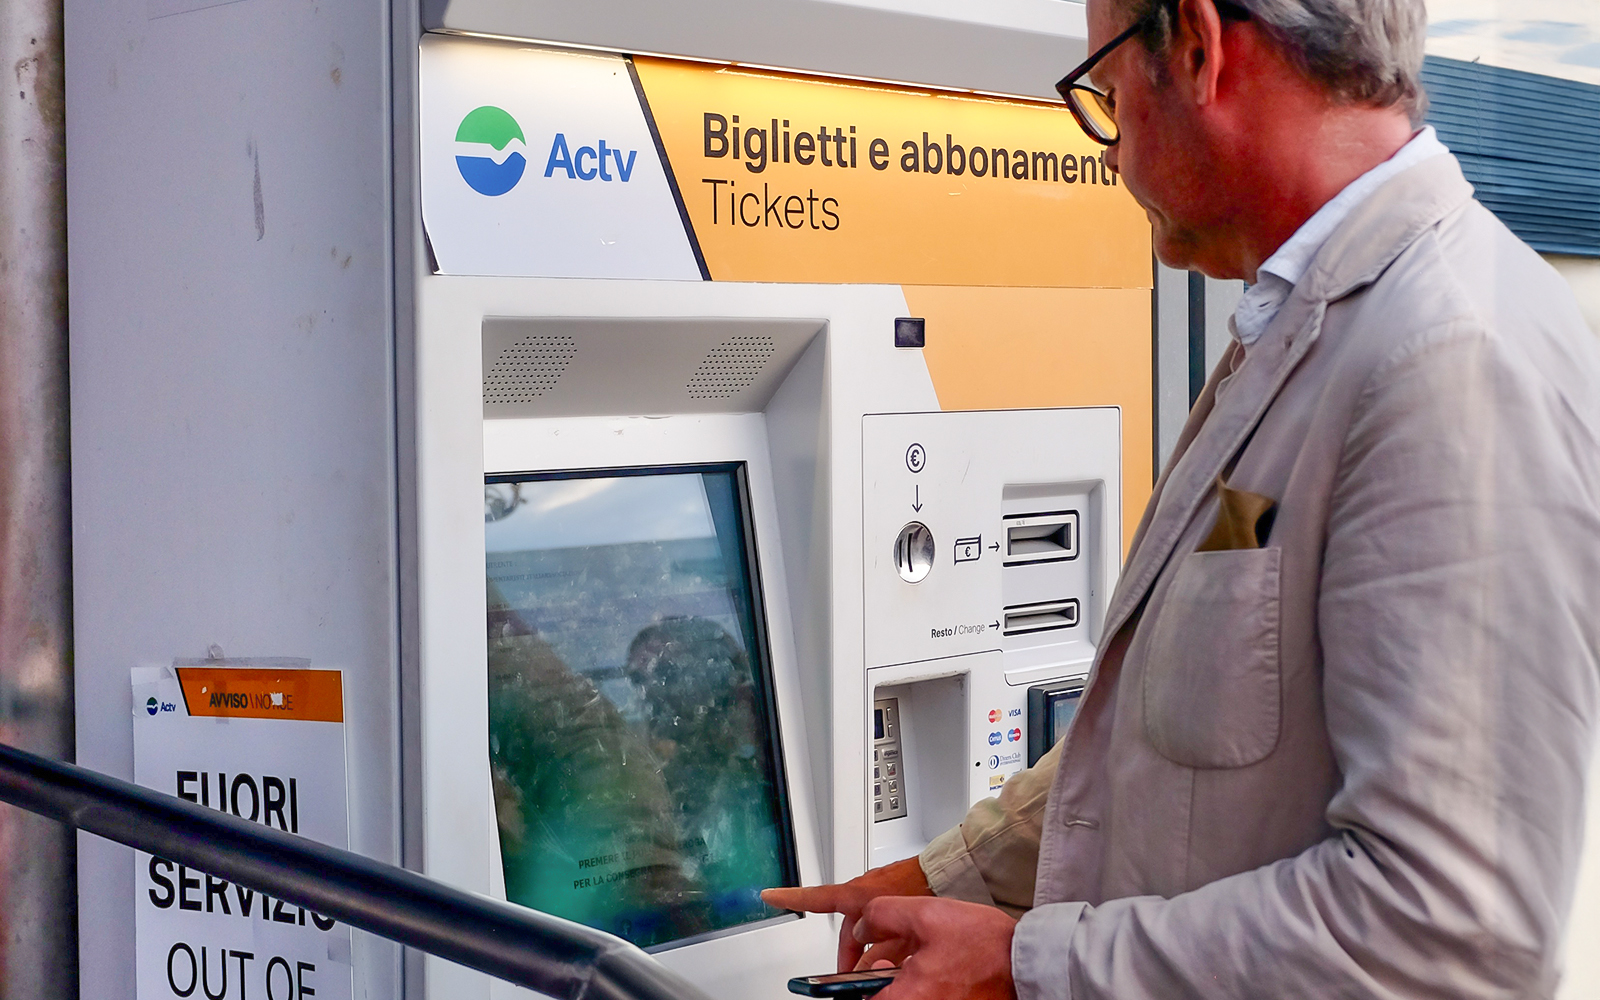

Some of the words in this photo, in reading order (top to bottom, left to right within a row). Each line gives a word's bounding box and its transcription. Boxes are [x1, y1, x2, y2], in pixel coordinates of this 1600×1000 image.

[544, 133, 637, 183] Actv
[703, 113, 856, 174] Biglietti
[869, 136, 889, 167] e
[702, 179, 840, 231] Tickets
[931, 628, 953, 638] Resto
[959, 624, 985, 634] Change
[161, 701, 176, 713] Actv
[209, 693, 248, 709] AVVISO
[255, 694, 294, 710] NOCE
[1008, 709, 1021, 717] VISA
[148, 854, 335, 931] SERV
[573, 878, 591, 890] PER
[593, 875, 605, 886] LA
[167, 942, 255, 1000] OUT
